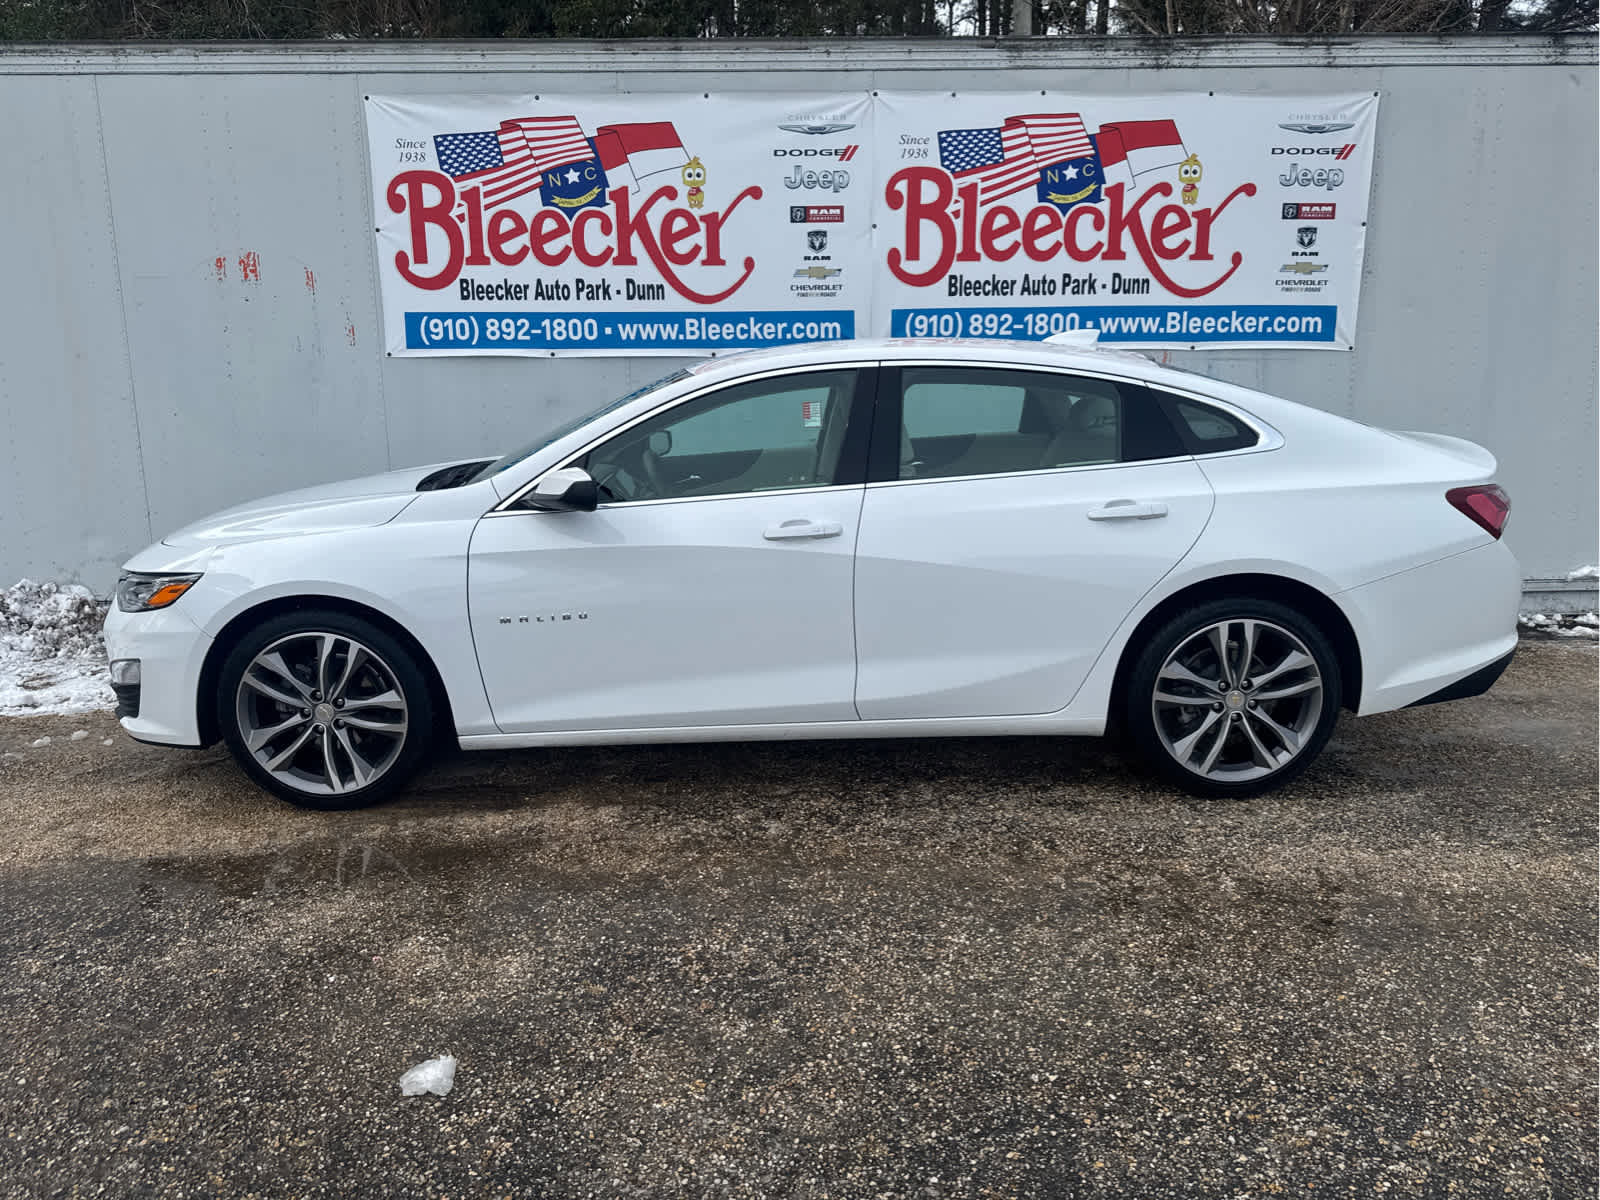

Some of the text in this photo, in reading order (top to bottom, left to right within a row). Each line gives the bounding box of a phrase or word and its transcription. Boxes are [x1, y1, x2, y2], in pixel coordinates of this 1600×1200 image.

[395, 138, 426, 149] Since
[899, 134, 930, 145] Since
[400, 151, 426, 163] 1938
[774, 149, 848, 157] DODGE
[901, 147, 929, 159] 1938
[1272, 147, 1345, 155] DODGE
[548, 166, 597, 188] N C
[784, 165, 850, 193] Jeep
[1047, 163, 1095, 183] N C
[1279, 163, 1345, 191] Jeep
[387, 170, 763, 304] Bleecker
[885, 166, 1257, 298] Bleecker
[460, 278, 529, 301] Bleecker
[534, 278, 571, 301] Auto
[575, 278, 612, 301] Park
[626, 278, 665, 301] Dunn
[948, 273, 1017, 297] Bleecker
[1020, 273, 1057, 296] Auto
[1061, 273, 1097, 296] Park
[1112, 273, 1150, 295] Dunn
[420, 315, 842, 345] (910) 892-1800 www.Bleecker.com
[904, 310, 1322, 338] (910) 892-1800 www.Bleecker.com
[499, 611, 589, 624] MALIBU
